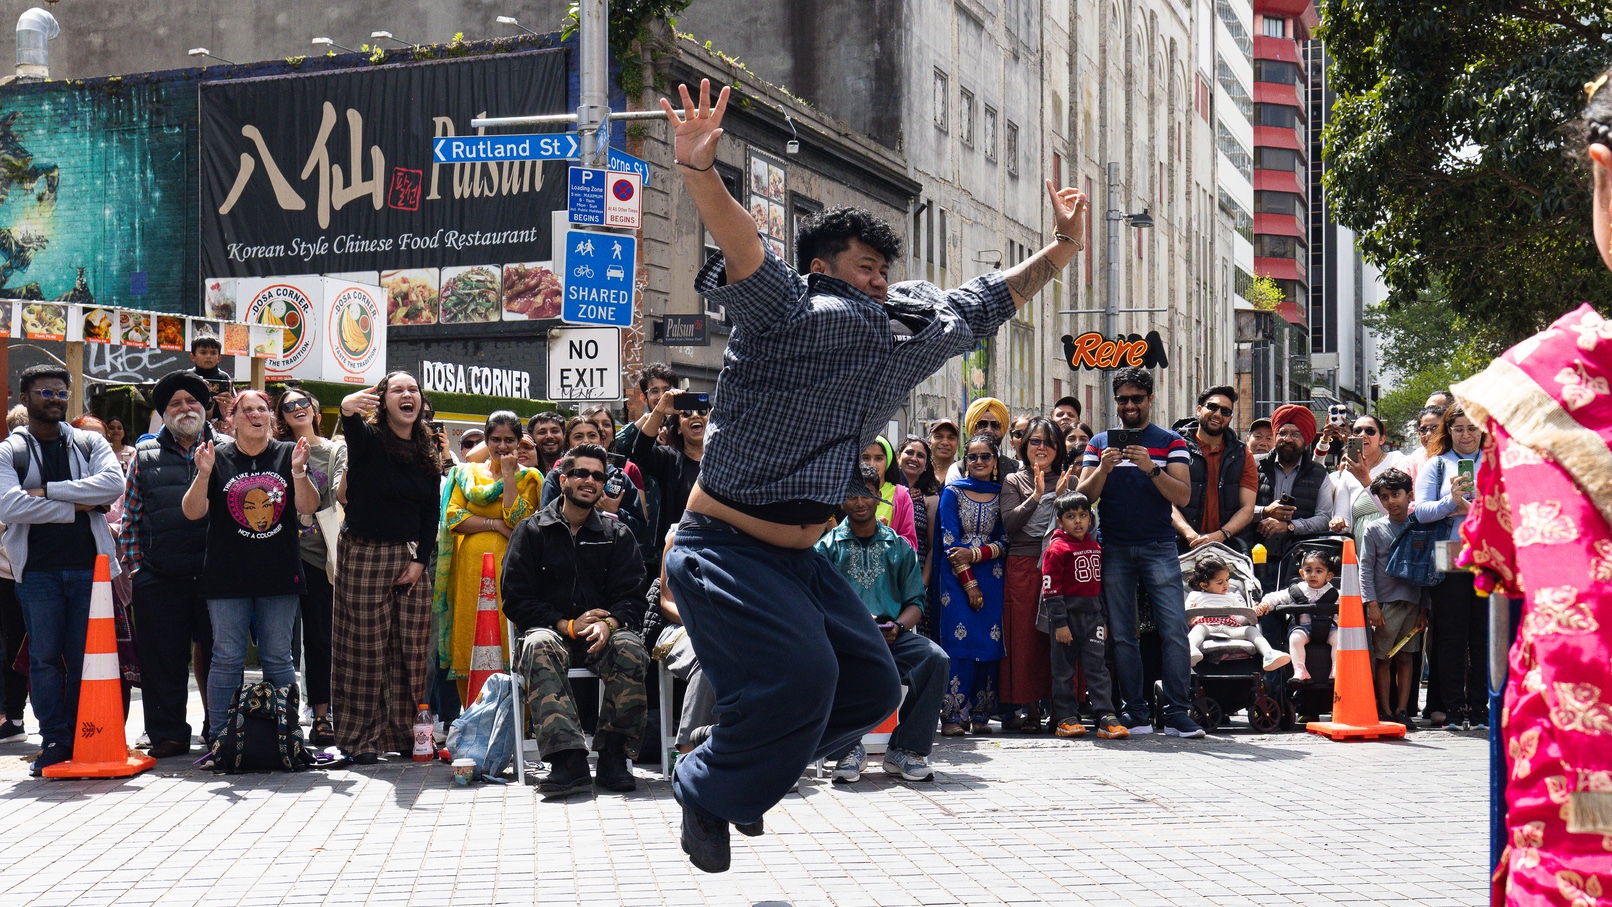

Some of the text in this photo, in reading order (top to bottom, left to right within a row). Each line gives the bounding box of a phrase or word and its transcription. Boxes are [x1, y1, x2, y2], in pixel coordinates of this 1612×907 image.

[452, 138, 561, 158] Rutland St
[218, 101, 386, 230] 八仙
[582, 171, 593, 184] P
[571, 184, 591, 193] Loading
[574, 213, 599, 222] BEGINS
[610, 214, 635, 223] BEGINS
[227, 226, 538, 262] Korean Style Chinese Food Restaurant
[253, 288, 309, 314] DOSA CORNER
[335, 291, 377, 317] DOSA CORNER
[569, 286, 628, 304] SHARED
[577, 304, 616, 321] ZONE
[665, 318, 695, 337] Palsun
[282, 343, 310, 367] TRADITION
[335, 347, 347, 365] TASTE
[356, 347, 377, 368] TRADITION
[569, 339, 599, 359] NO
[1071, 331, 1149, 368] Rere
[423, 360, 531, 399] DOSA CORNER
[560, 368, 608, 388] EXIT
[223, 477, 237, 492] THINK
[235, 472, 249, 480] LIKE
[261, 471, 288, 488] ANCESTOR
[238, 529, 251, 538] NOT
[1074, 554, 1101, 582] 88
[1043, 575, 1051, 589] a
[1096, 626, 1104, 640] a
